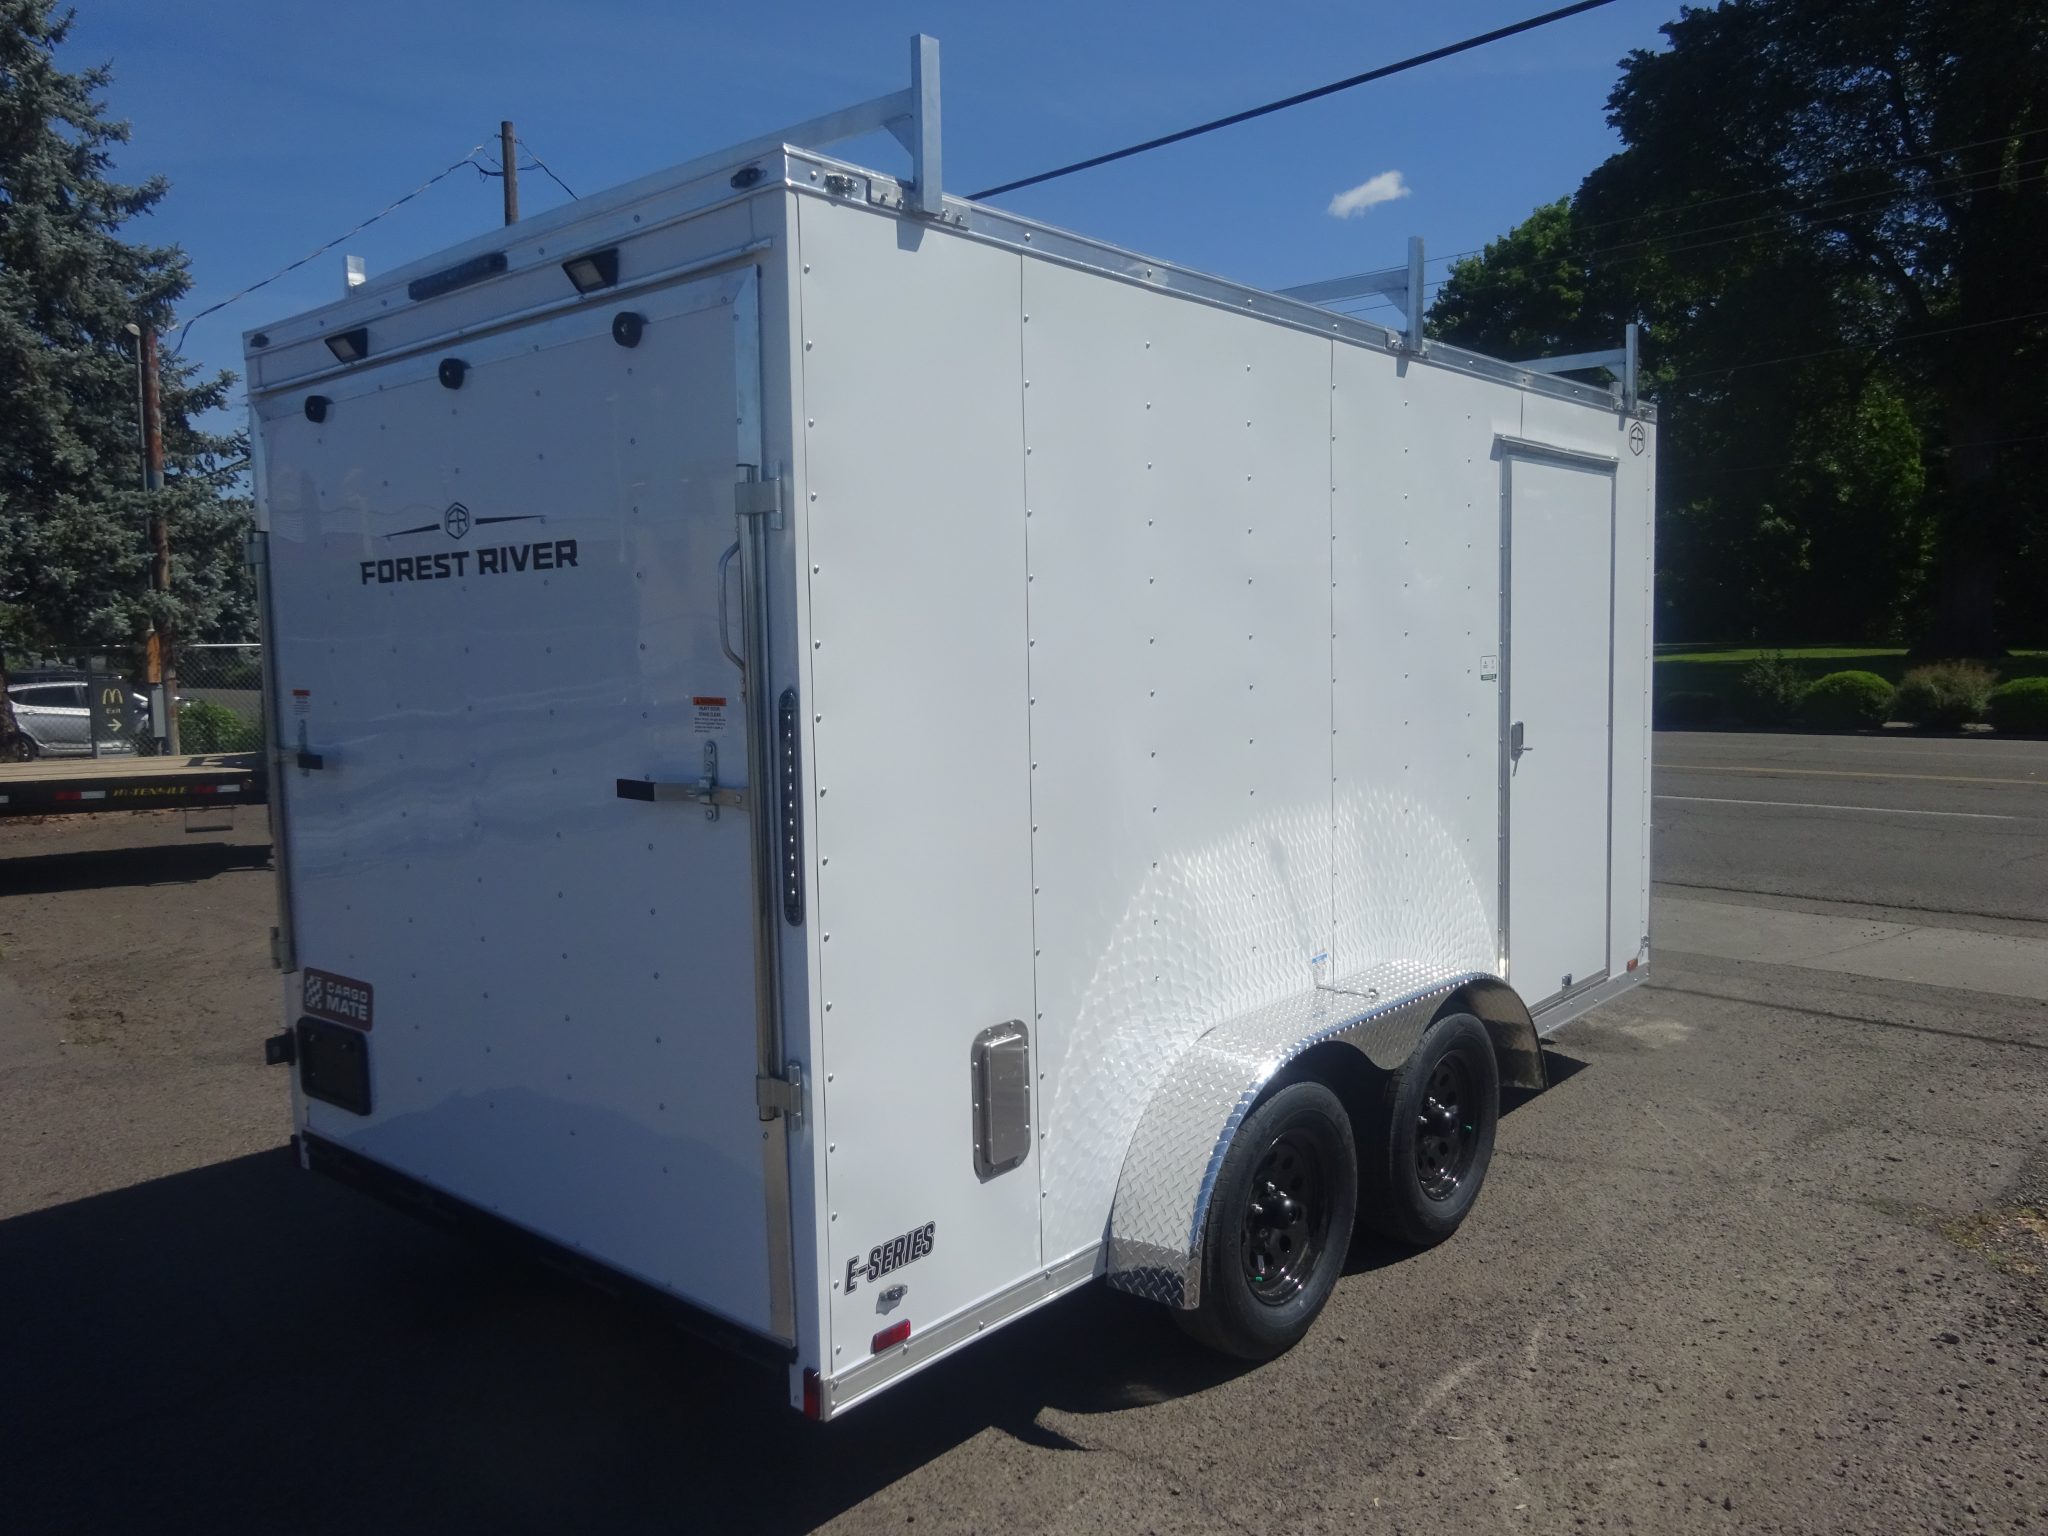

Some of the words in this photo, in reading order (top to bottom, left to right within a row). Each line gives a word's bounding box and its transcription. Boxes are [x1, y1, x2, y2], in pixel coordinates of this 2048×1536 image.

[360, 551, 469, 585] FOREST
[477, 539, 579, 575] RIVER
[105, 707, 121, 715] Exit
[326, 981, 368, 1003] CARGO
[326, 994, 368, 1021] MATE
[844, 1220, 936, 1296] E-SERIES
